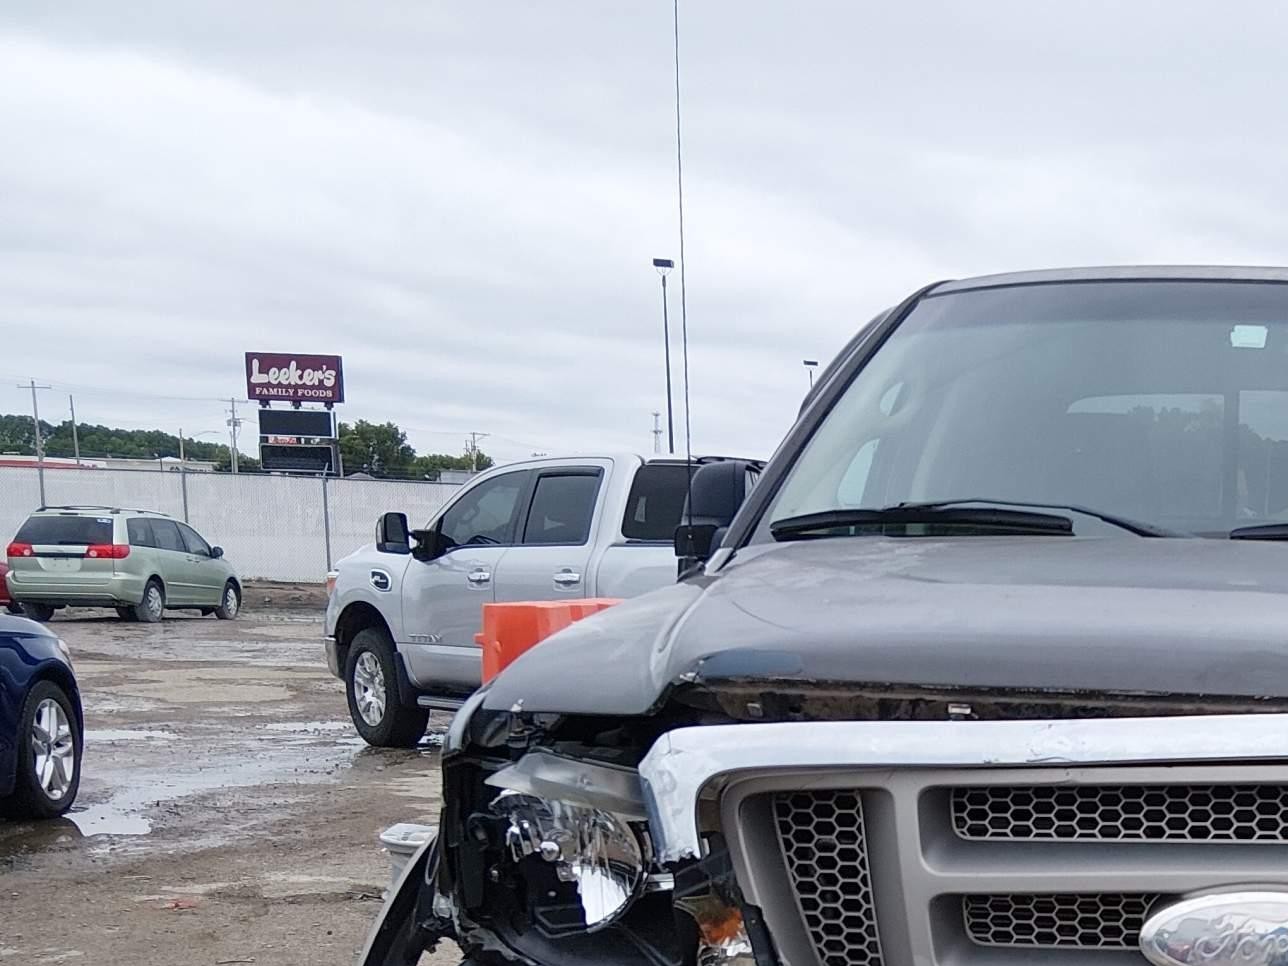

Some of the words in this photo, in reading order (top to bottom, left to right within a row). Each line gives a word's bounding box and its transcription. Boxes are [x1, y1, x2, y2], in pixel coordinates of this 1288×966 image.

[250, 358, 336, 387] Leeker's
[255, 387, 295, 397] FAMILY
[298, 388, 333, 398] FOODS
